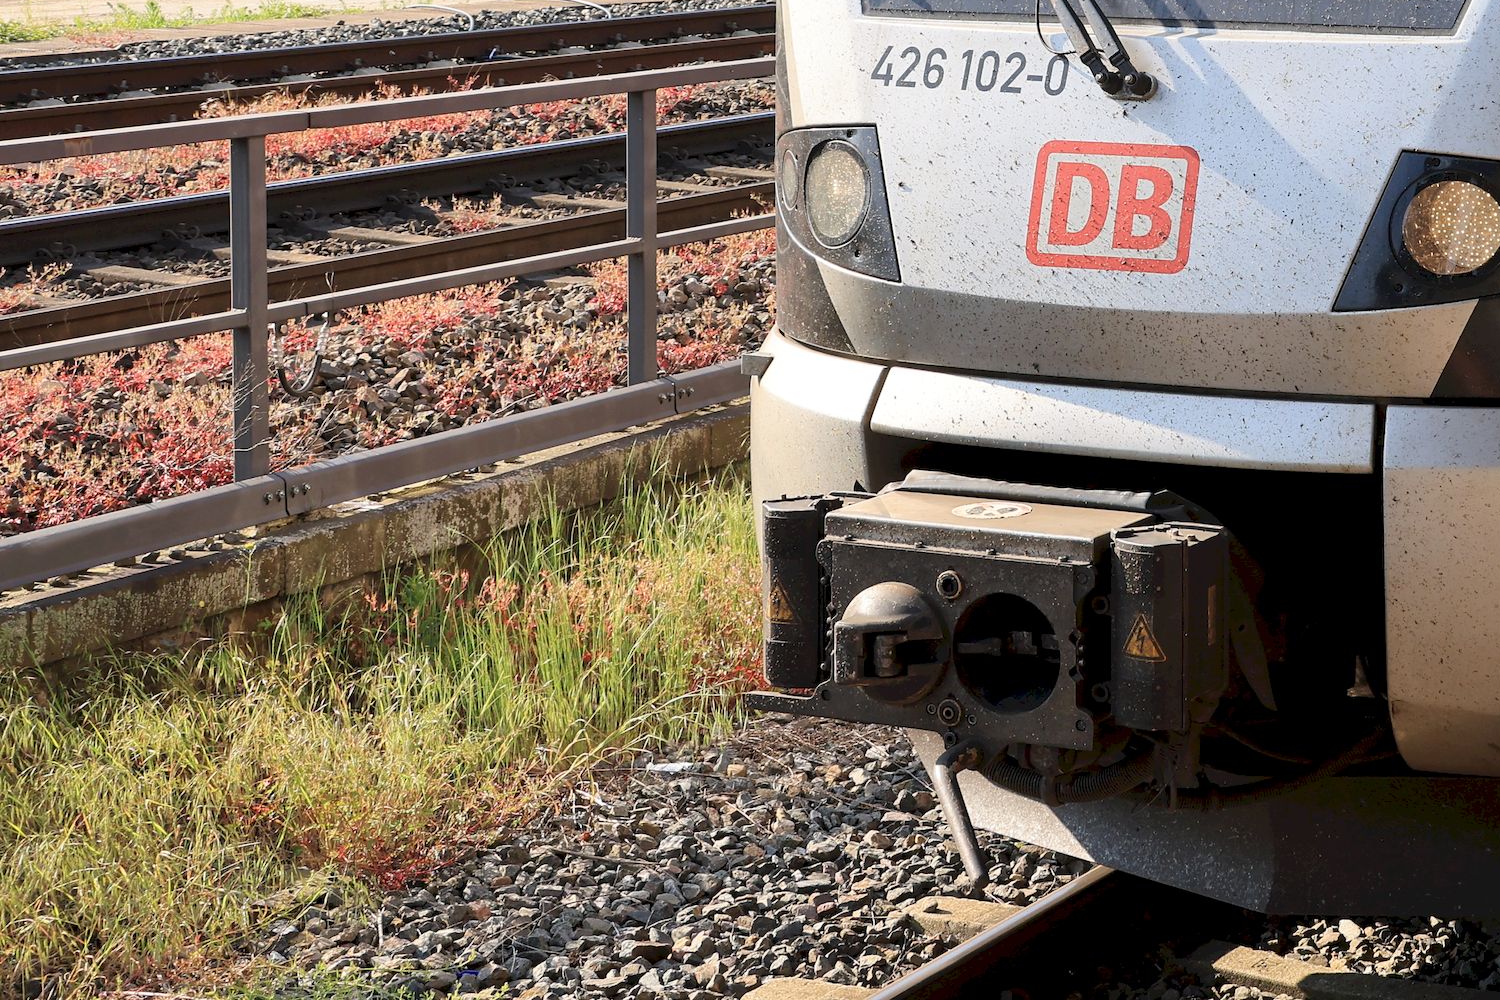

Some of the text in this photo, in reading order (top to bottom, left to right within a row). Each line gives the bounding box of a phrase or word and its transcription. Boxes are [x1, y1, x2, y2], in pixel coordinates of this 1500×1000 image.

[870, 45, 1071, 97] 426 102-0
[1044, 159, 1177, 253] DB
